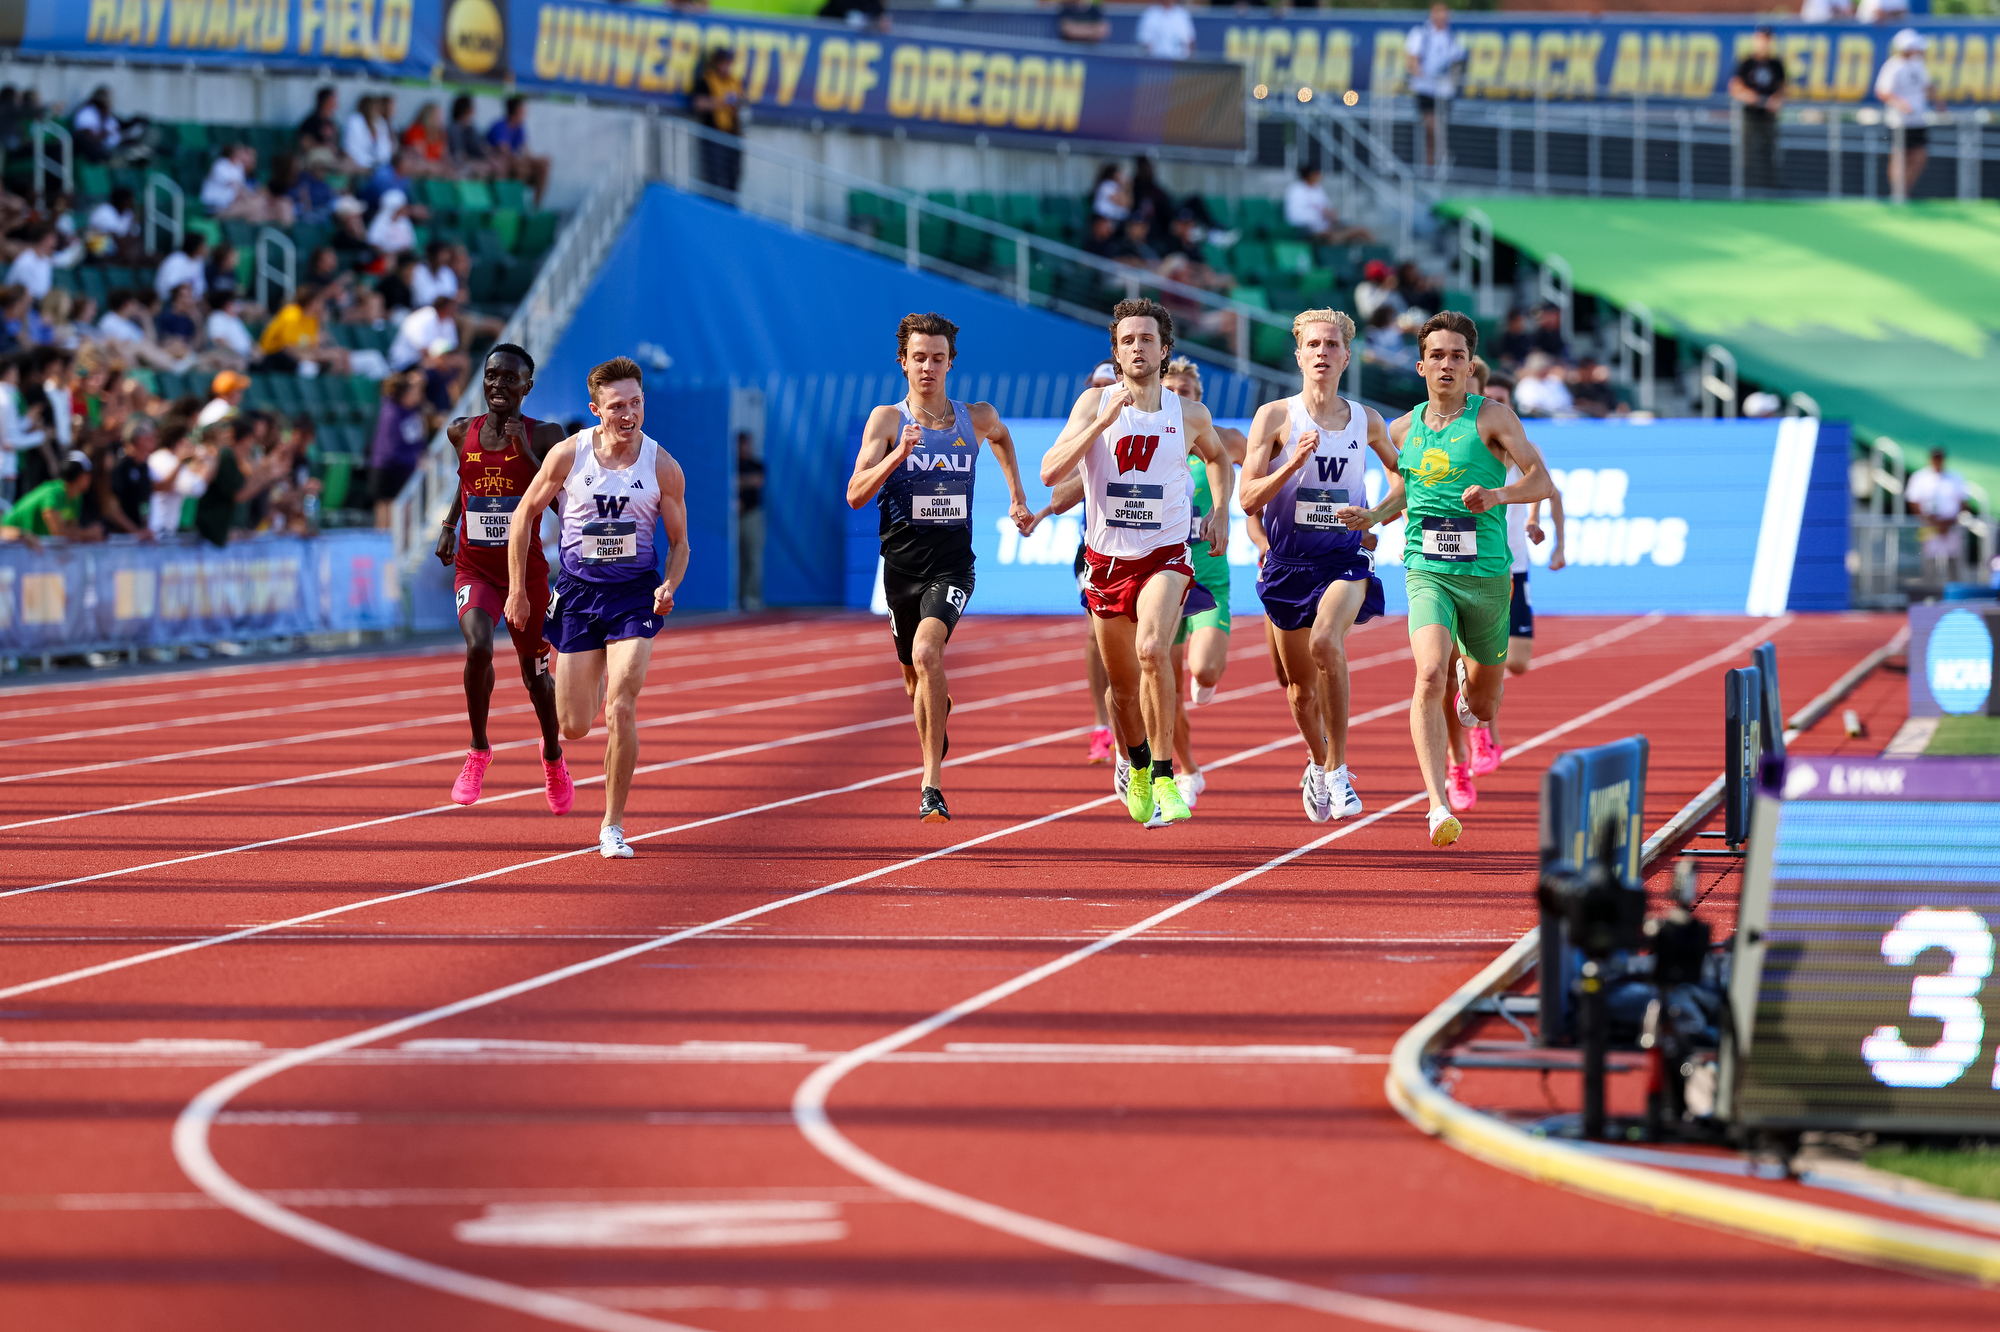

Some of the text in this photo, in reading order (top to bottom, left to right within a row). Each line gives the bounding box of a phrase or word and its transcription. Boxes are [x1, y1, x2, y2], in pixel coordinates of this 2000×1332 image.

[87, 0, 413, 62] HAYWARD FIELD
[1224, 27, 1355, 93] NCAA
[1609, 31, 1722, 98] AND
[813, 36, 883, 113] OF
[886, 44, 1086, 133] OREGON
[1114, 435, 1160, 477] W
[906, 453, 973, 472] NAU
[1315, 456, 1349, 483] W
[474, 476, 514, 490] STATE
[593, 493, 630, 519] W
[931, 498, 951, 506] COLIN
[1124, 500, 1145, 509] ADAM
[920, 507, 961, 517] SAHLMAN
[1115, 508, 1153, 520] SPENCER
[1315, 505, 1332, 513] LUKE
[480, 516, 511, 525] EZEKIEL
[1306, 513, 1340, 524] HOUSER
[485, 526, 506, 538] ROP
[1436, 533, 1461, 542] ELLIOTT
[596, 538, 624, 546] NATHAN
[1437, 542, 1461, 553] COOK
[596, 546, 624, 556] GREEN
[951, 588, 964, 609] 8
